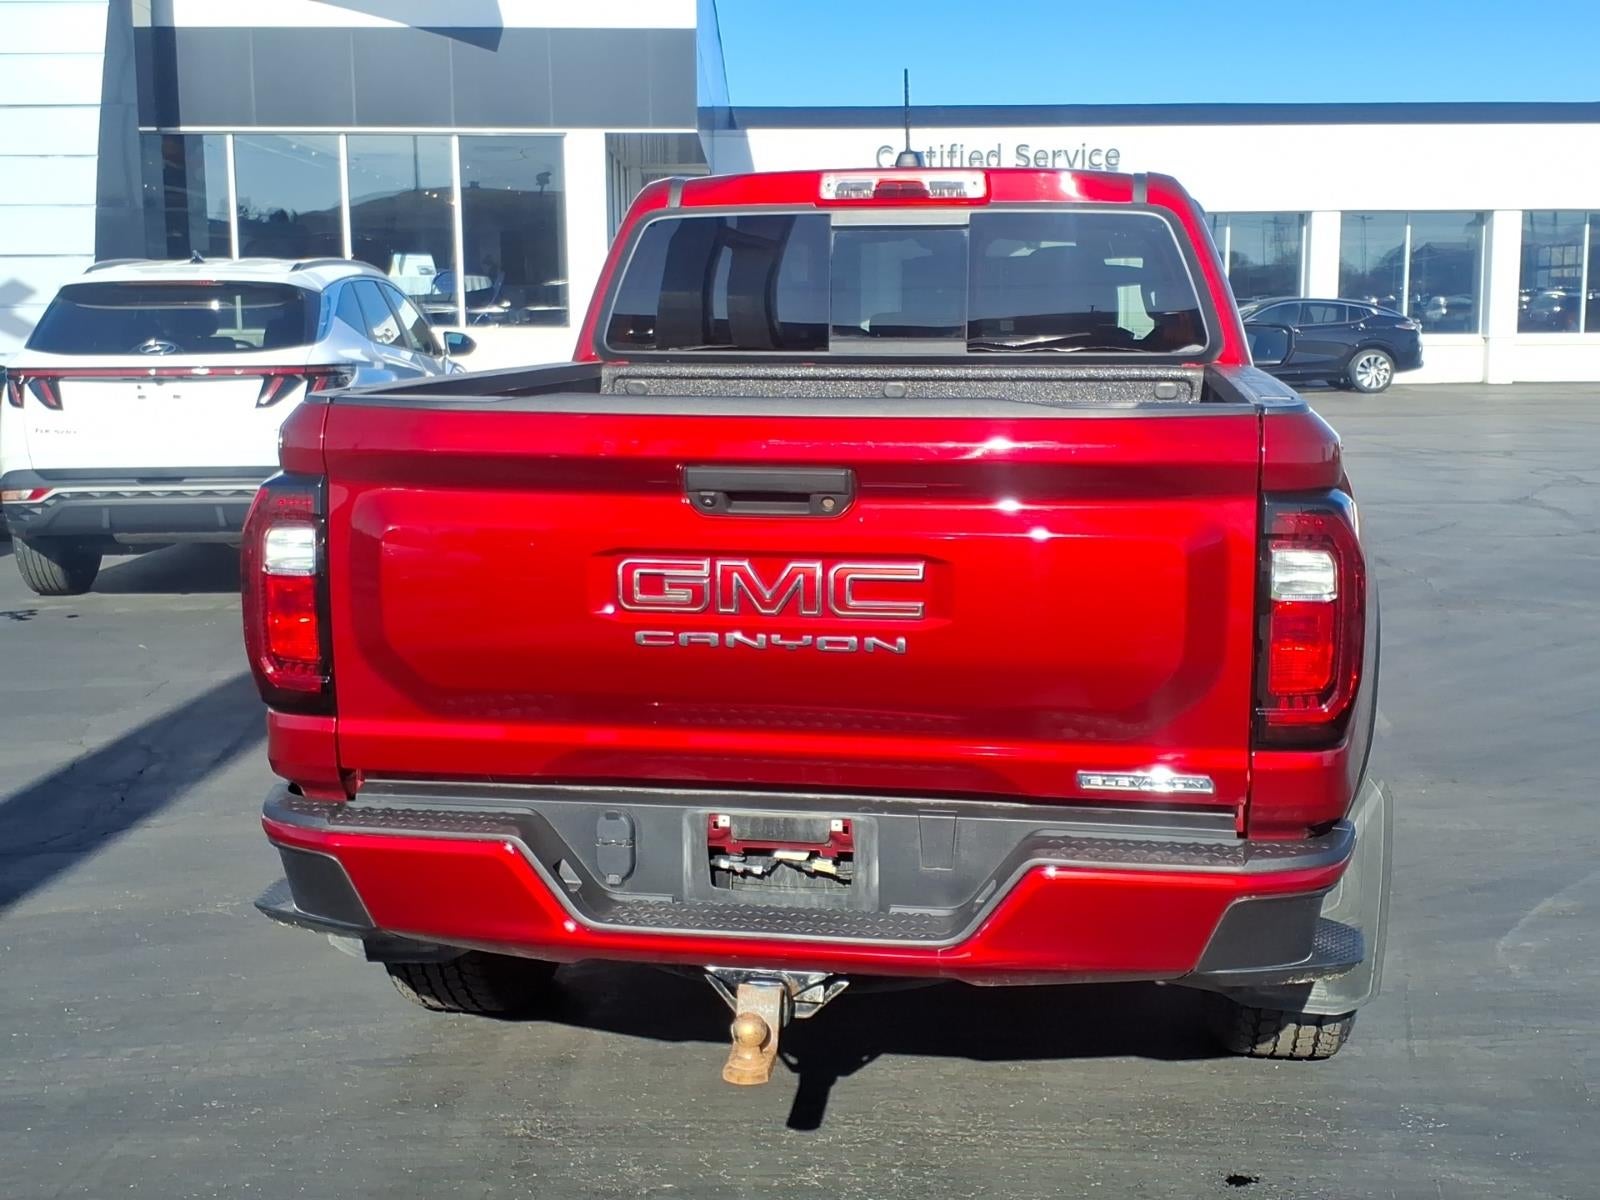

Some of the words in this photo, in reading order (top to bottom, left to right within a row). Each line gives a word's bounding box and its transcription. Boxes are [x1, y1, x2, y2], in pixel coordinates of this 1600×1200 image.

[876, 143, 1002, 168] Ctified
[1015, 143, 1121, 171] Service
[617, 557, 925, 618] GMC
[635, 630, 906, 653] CANYON
[1086, 775, 1205, 790] ELEVAON
